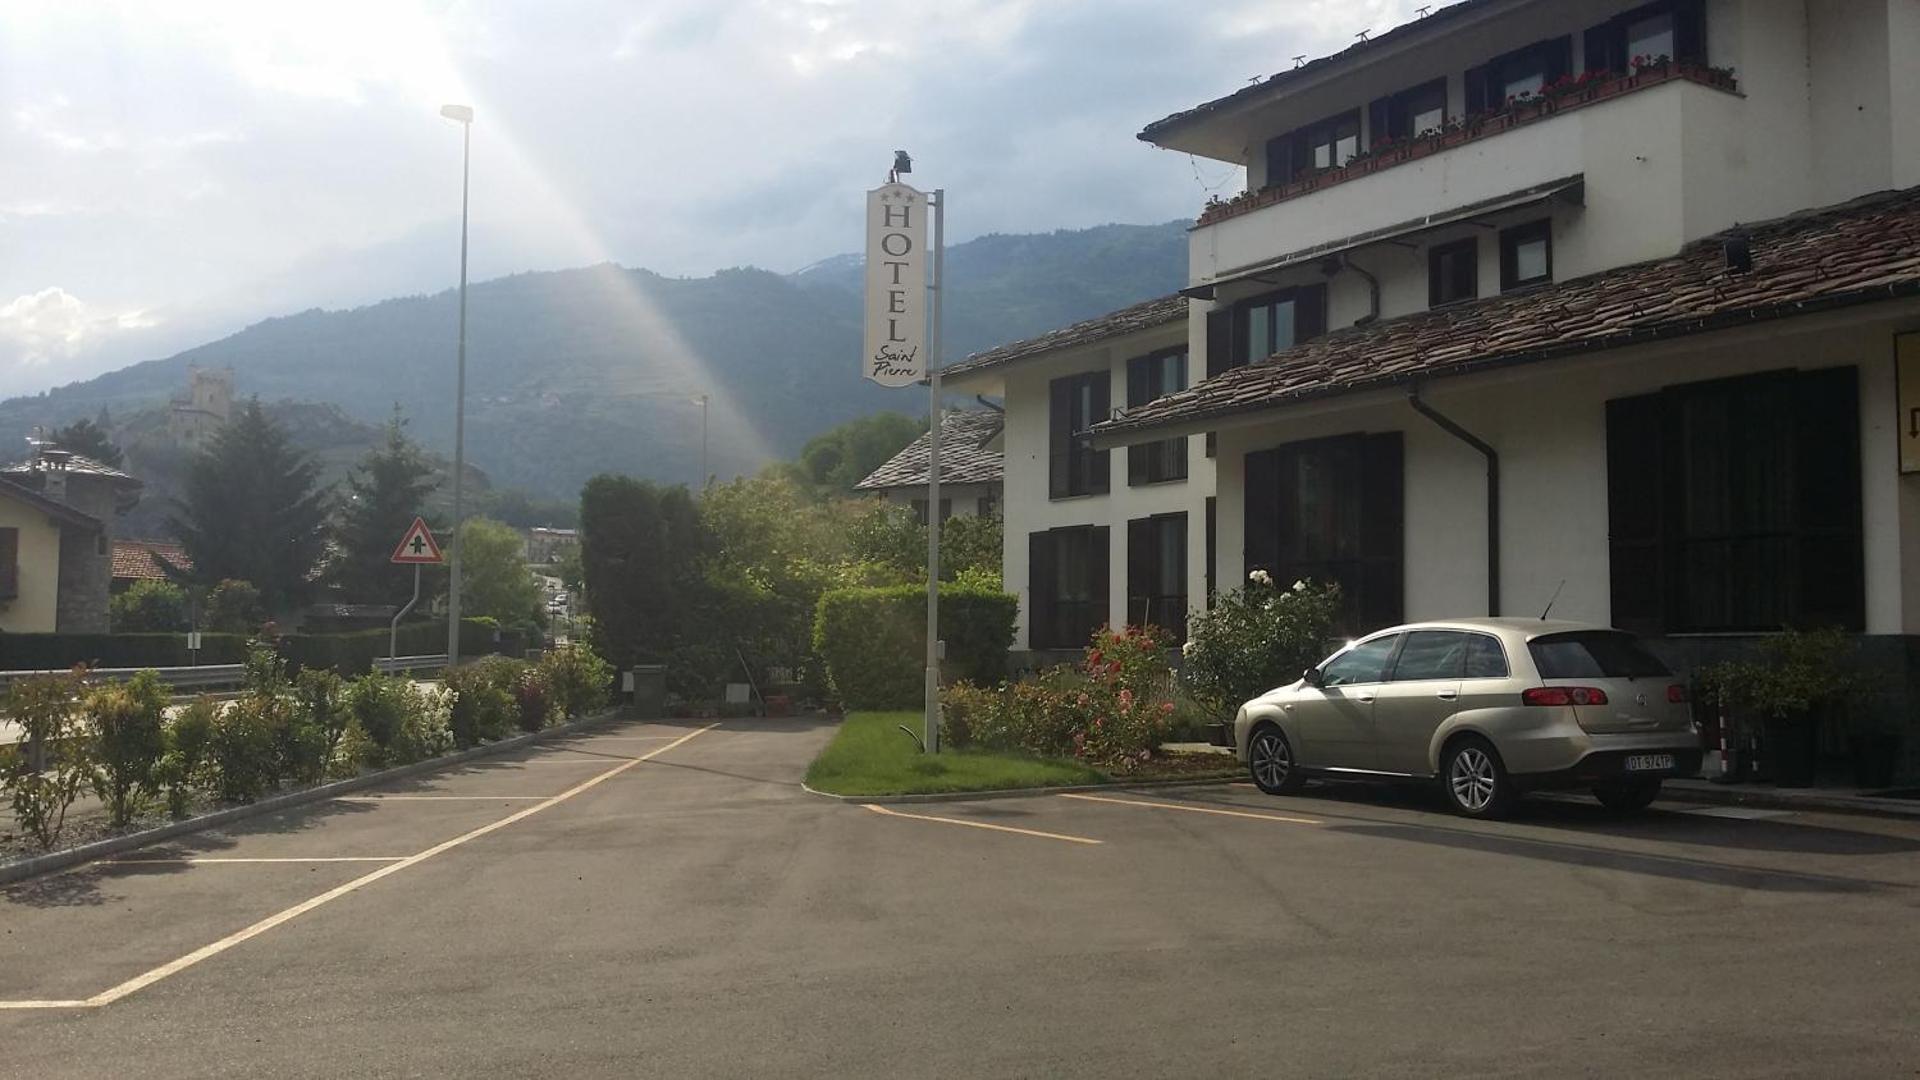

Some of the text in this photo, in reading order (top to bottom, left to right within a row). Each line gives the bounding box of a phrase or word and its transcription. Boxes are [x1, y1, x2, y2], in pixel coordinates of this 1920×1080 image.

[881, 204, 912, 342] HOTEL
[874, 344, 917, 363] Saint
[873, 360, 918, 377] Pierre
